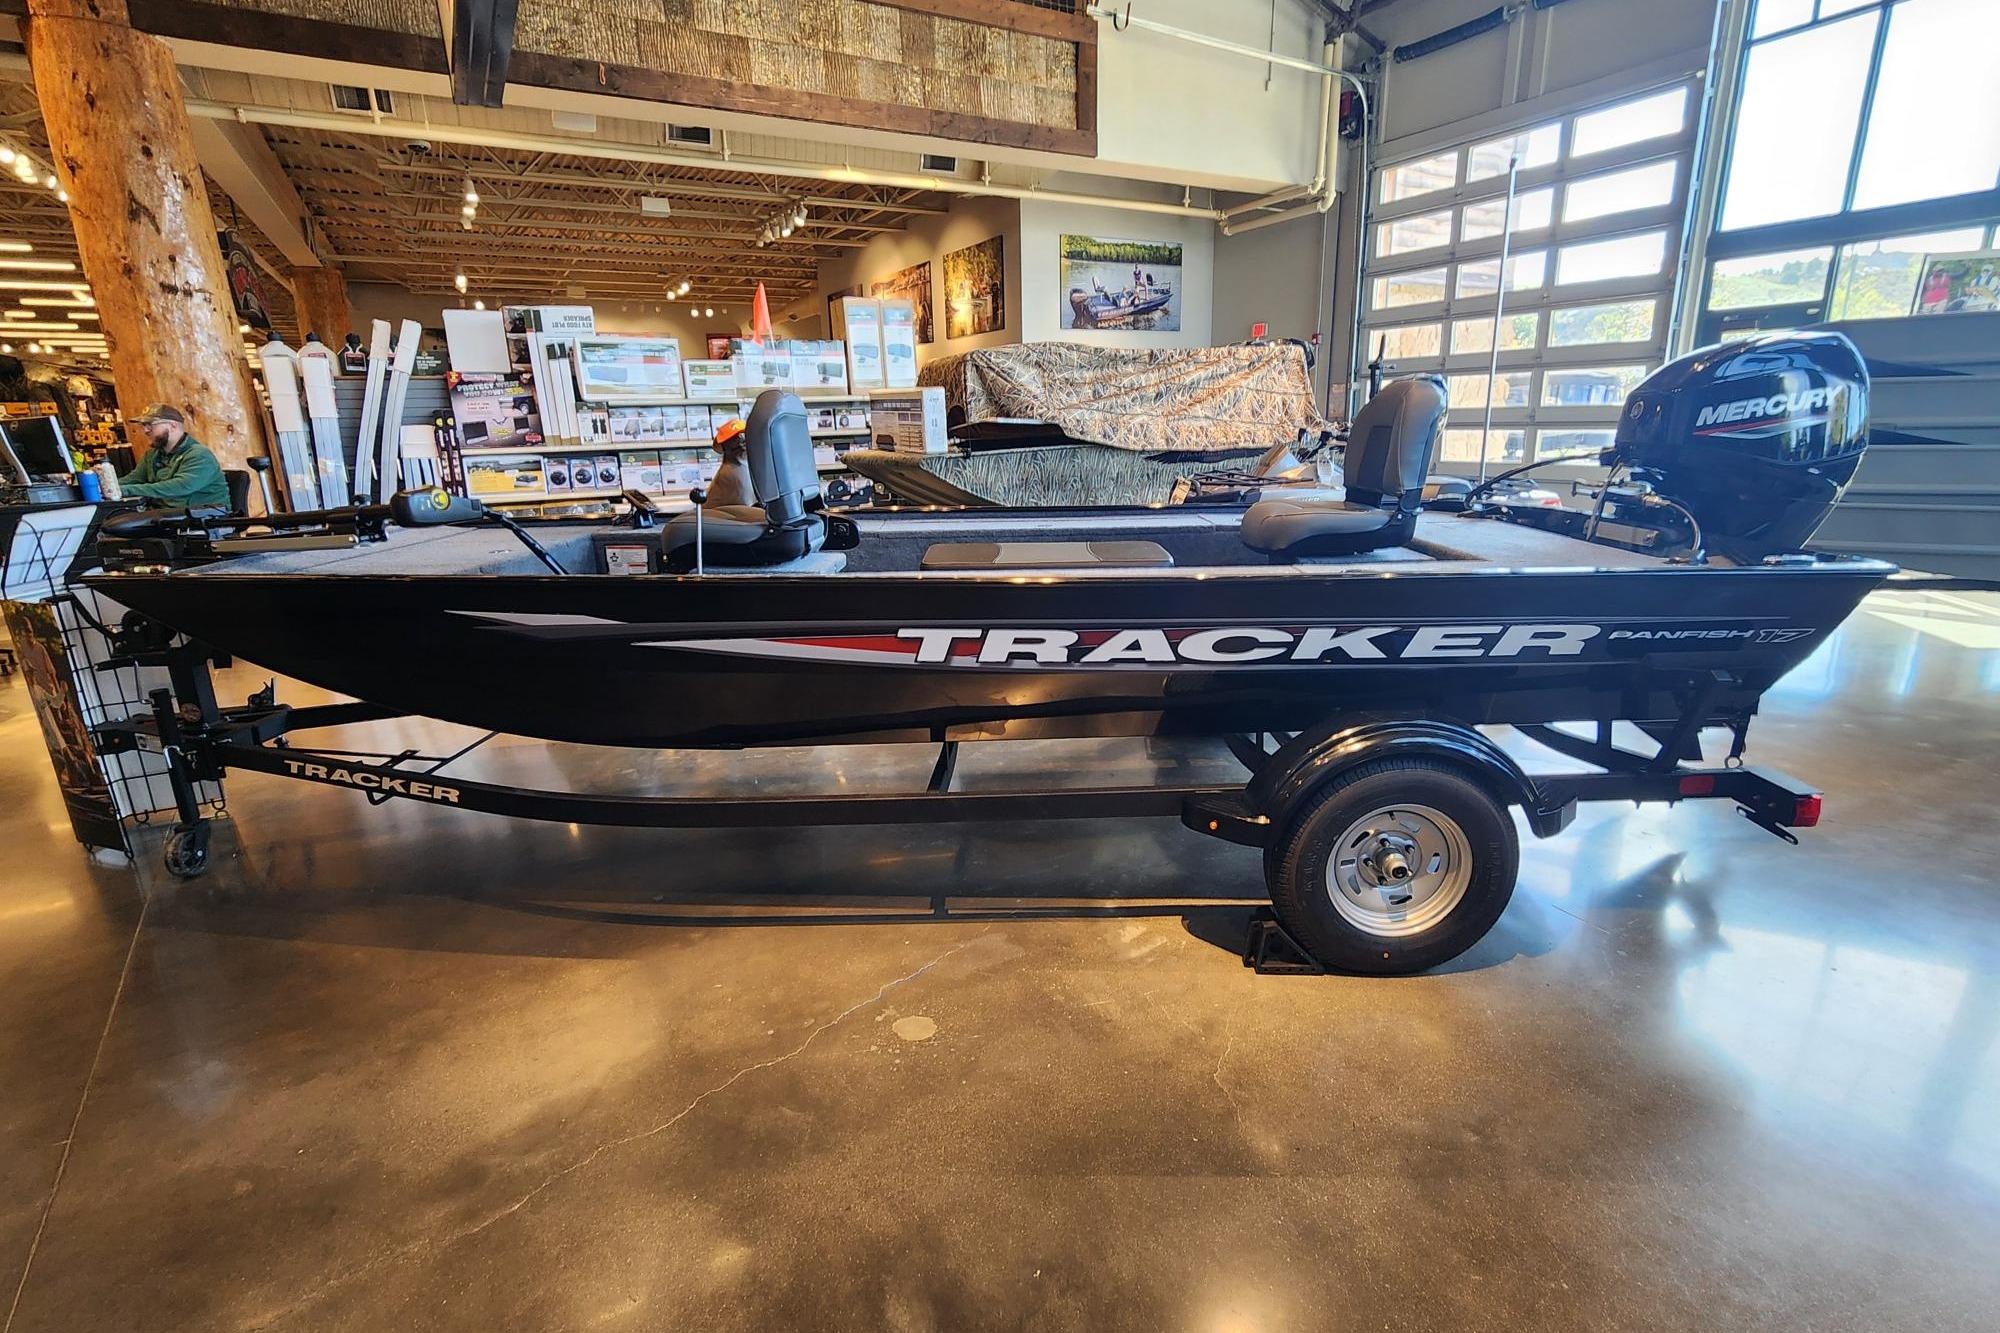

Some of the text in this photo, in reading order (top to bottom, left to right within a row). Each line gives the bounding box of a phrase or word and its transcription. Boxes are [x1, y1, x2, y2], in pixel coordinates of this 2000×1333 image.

[1695, 384, 1845, 427] MERCURY
[897, 623, 1817, 664] TRACKER PANFISH 17
[284, 760, 460, 803] TRACKER
